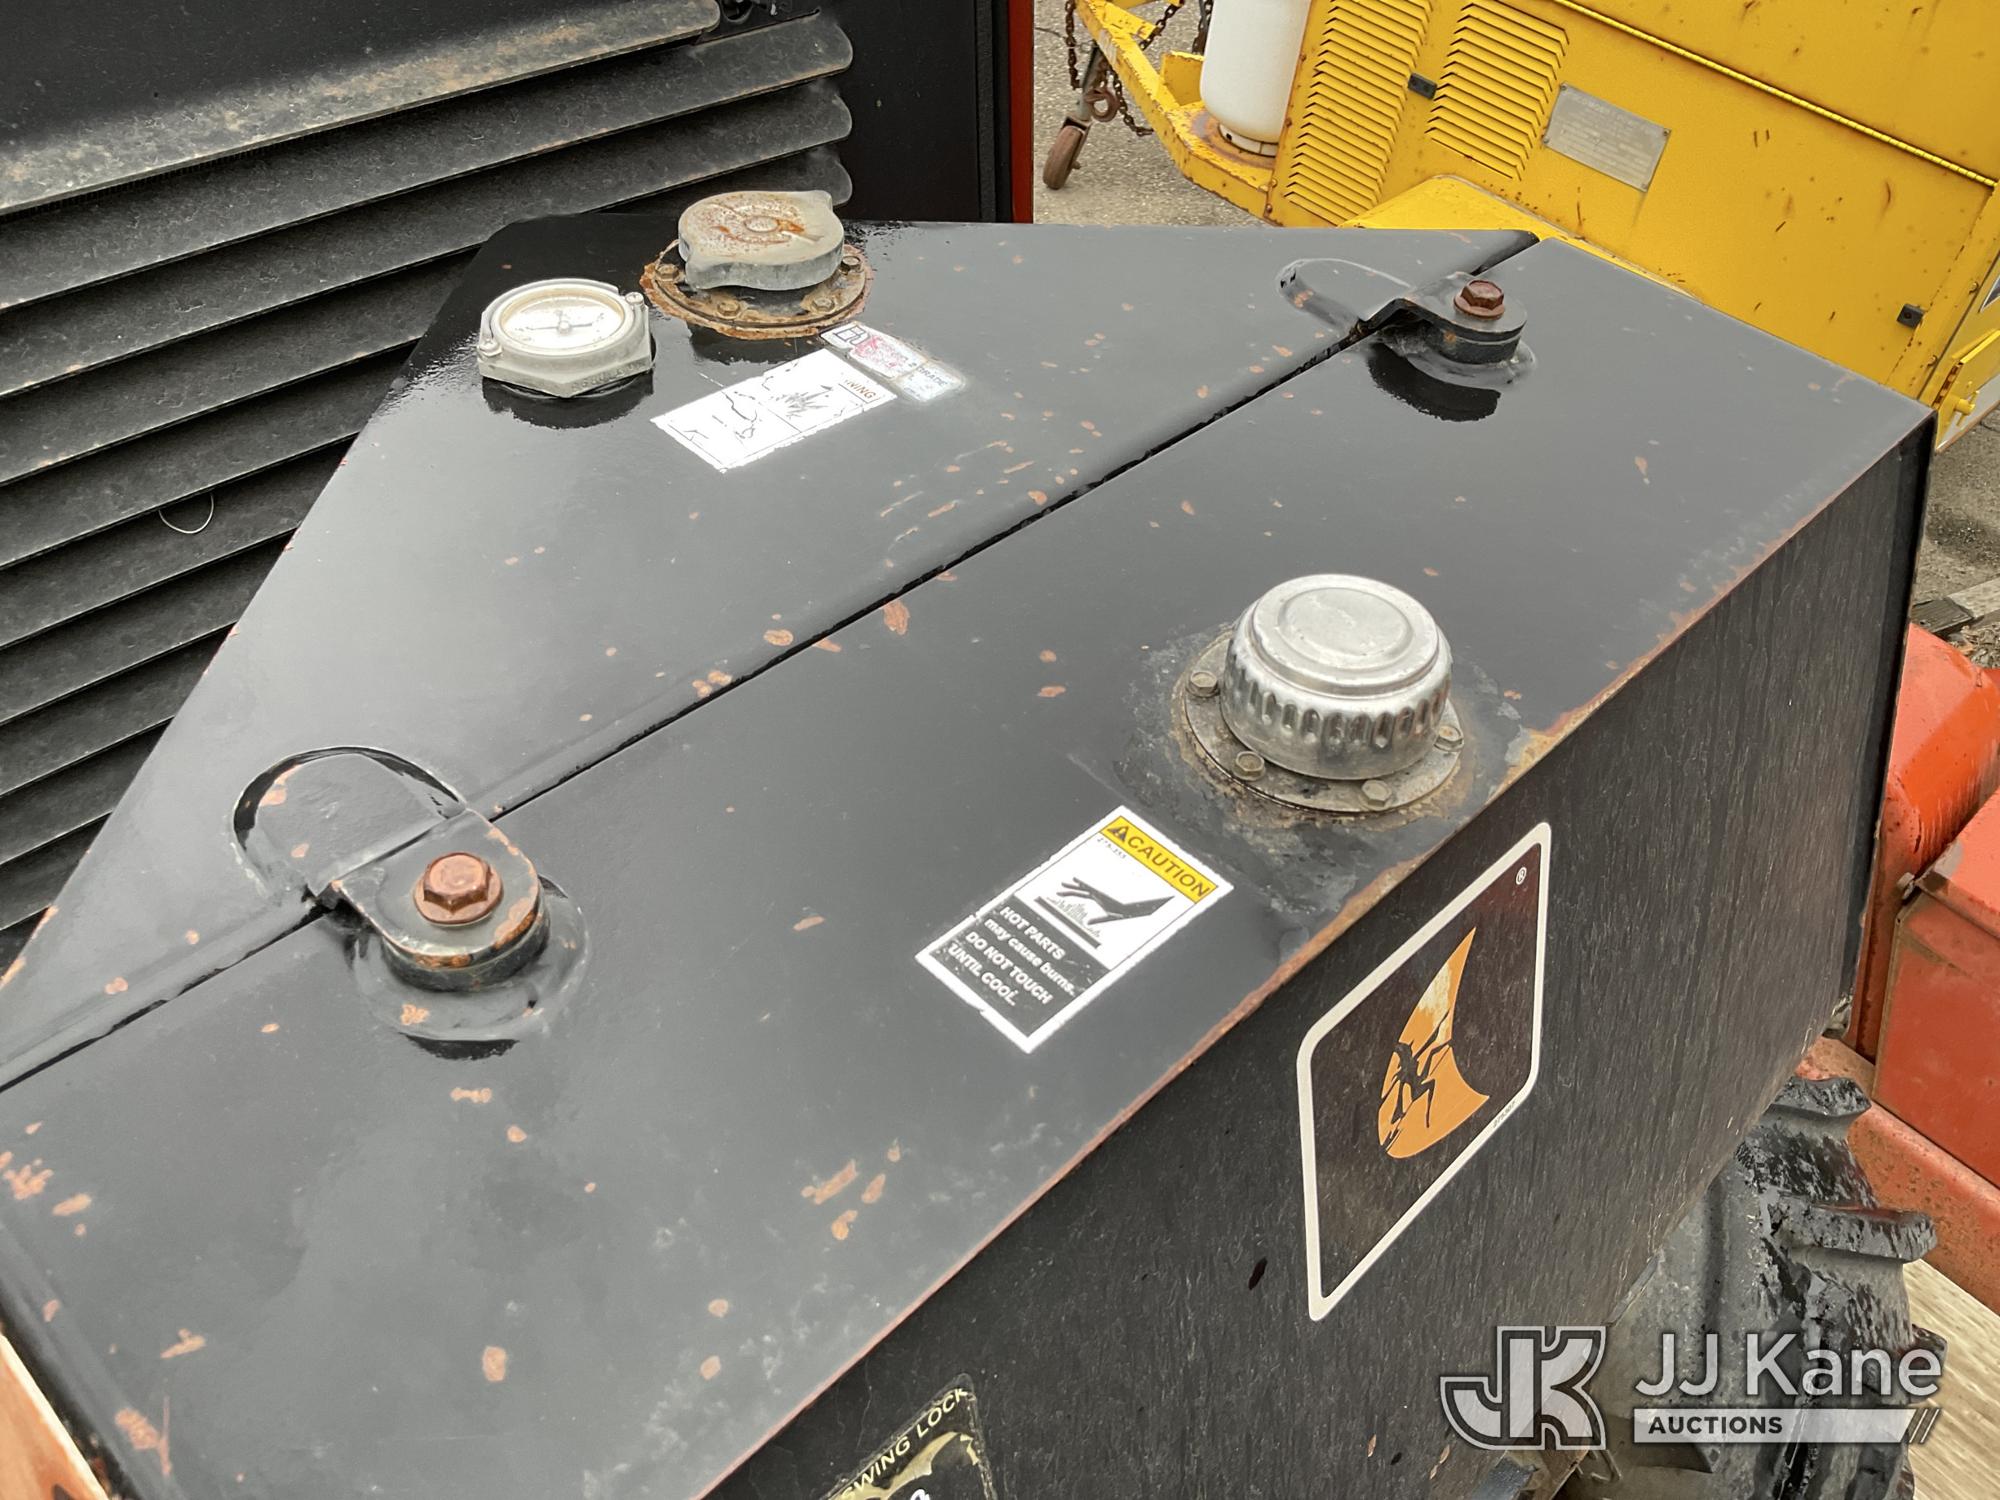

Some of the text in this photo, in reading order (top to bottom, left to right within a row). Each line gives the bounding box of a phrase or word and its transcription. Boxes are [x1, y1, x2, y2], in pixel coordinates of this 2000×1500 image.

[1128, 834, 1211, 899] CAUTION
[948, 942, 982, 977] UNTIL
[984, 918, 1012, 941] may
[1008, 937, 1043, 967] cause
[1000, 906, 1066, 960] HOT PARTS
[965, 931, 1054, 1004] DO NOT TOUCH
[841, 1387, 969, 1500] SWING LOCK
